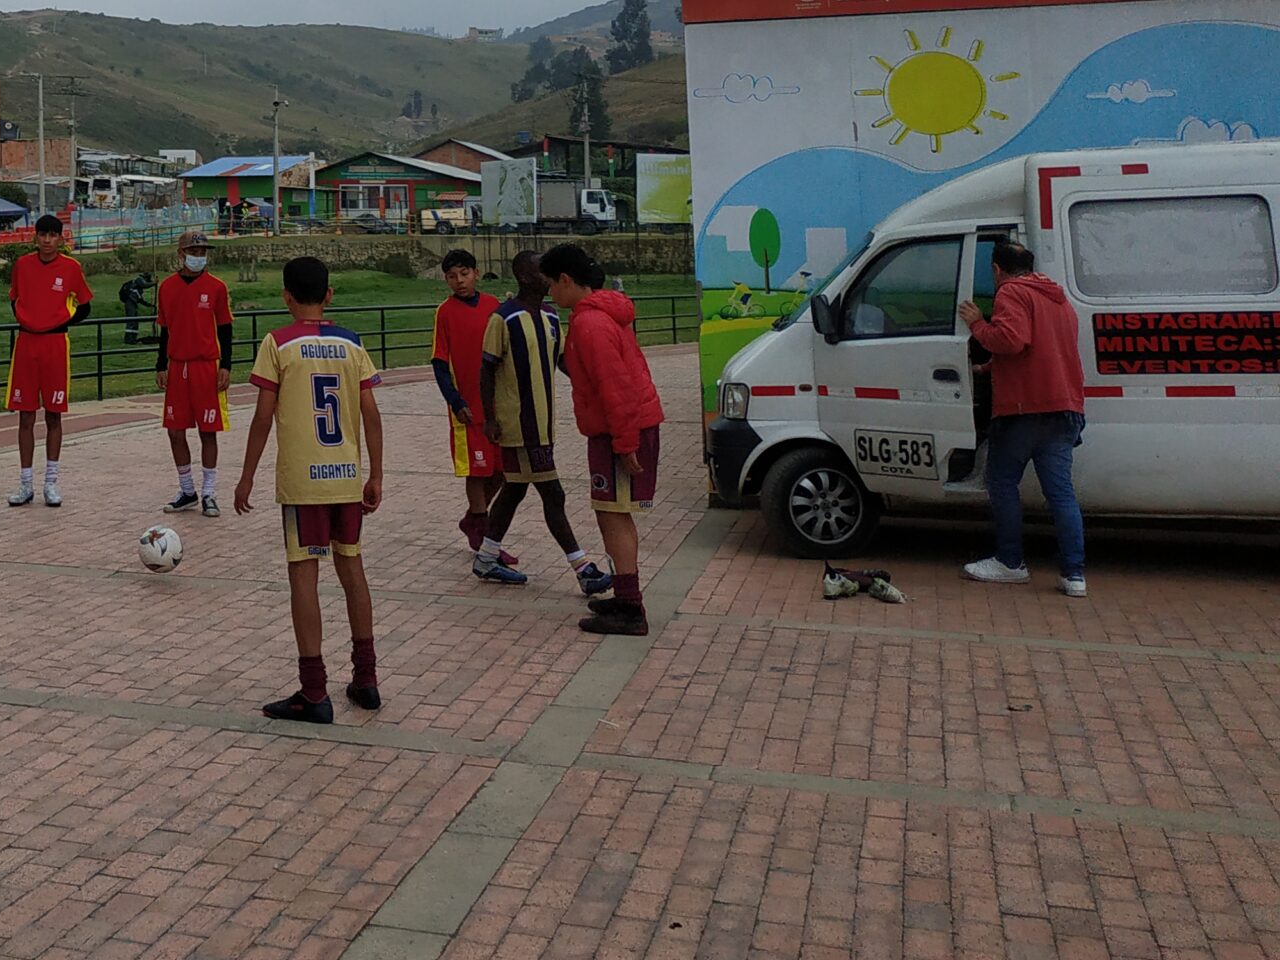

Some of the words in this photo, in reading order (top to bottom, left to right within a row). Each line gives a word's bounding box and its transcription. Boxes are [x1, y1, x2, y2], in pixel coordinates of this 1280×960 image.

[301, 344, 347, 359] AGUDELO
[51, 390, 65, 405] 19
[203, 408, 216, 424] 18
[311, 373, 344, 447] 5
[857, 435, 892, 464] SLG
[898, 439, 934, 468] 583
[309, 463, 357, 480] GIGANTES
[880, 465, 914, 475] COTA
